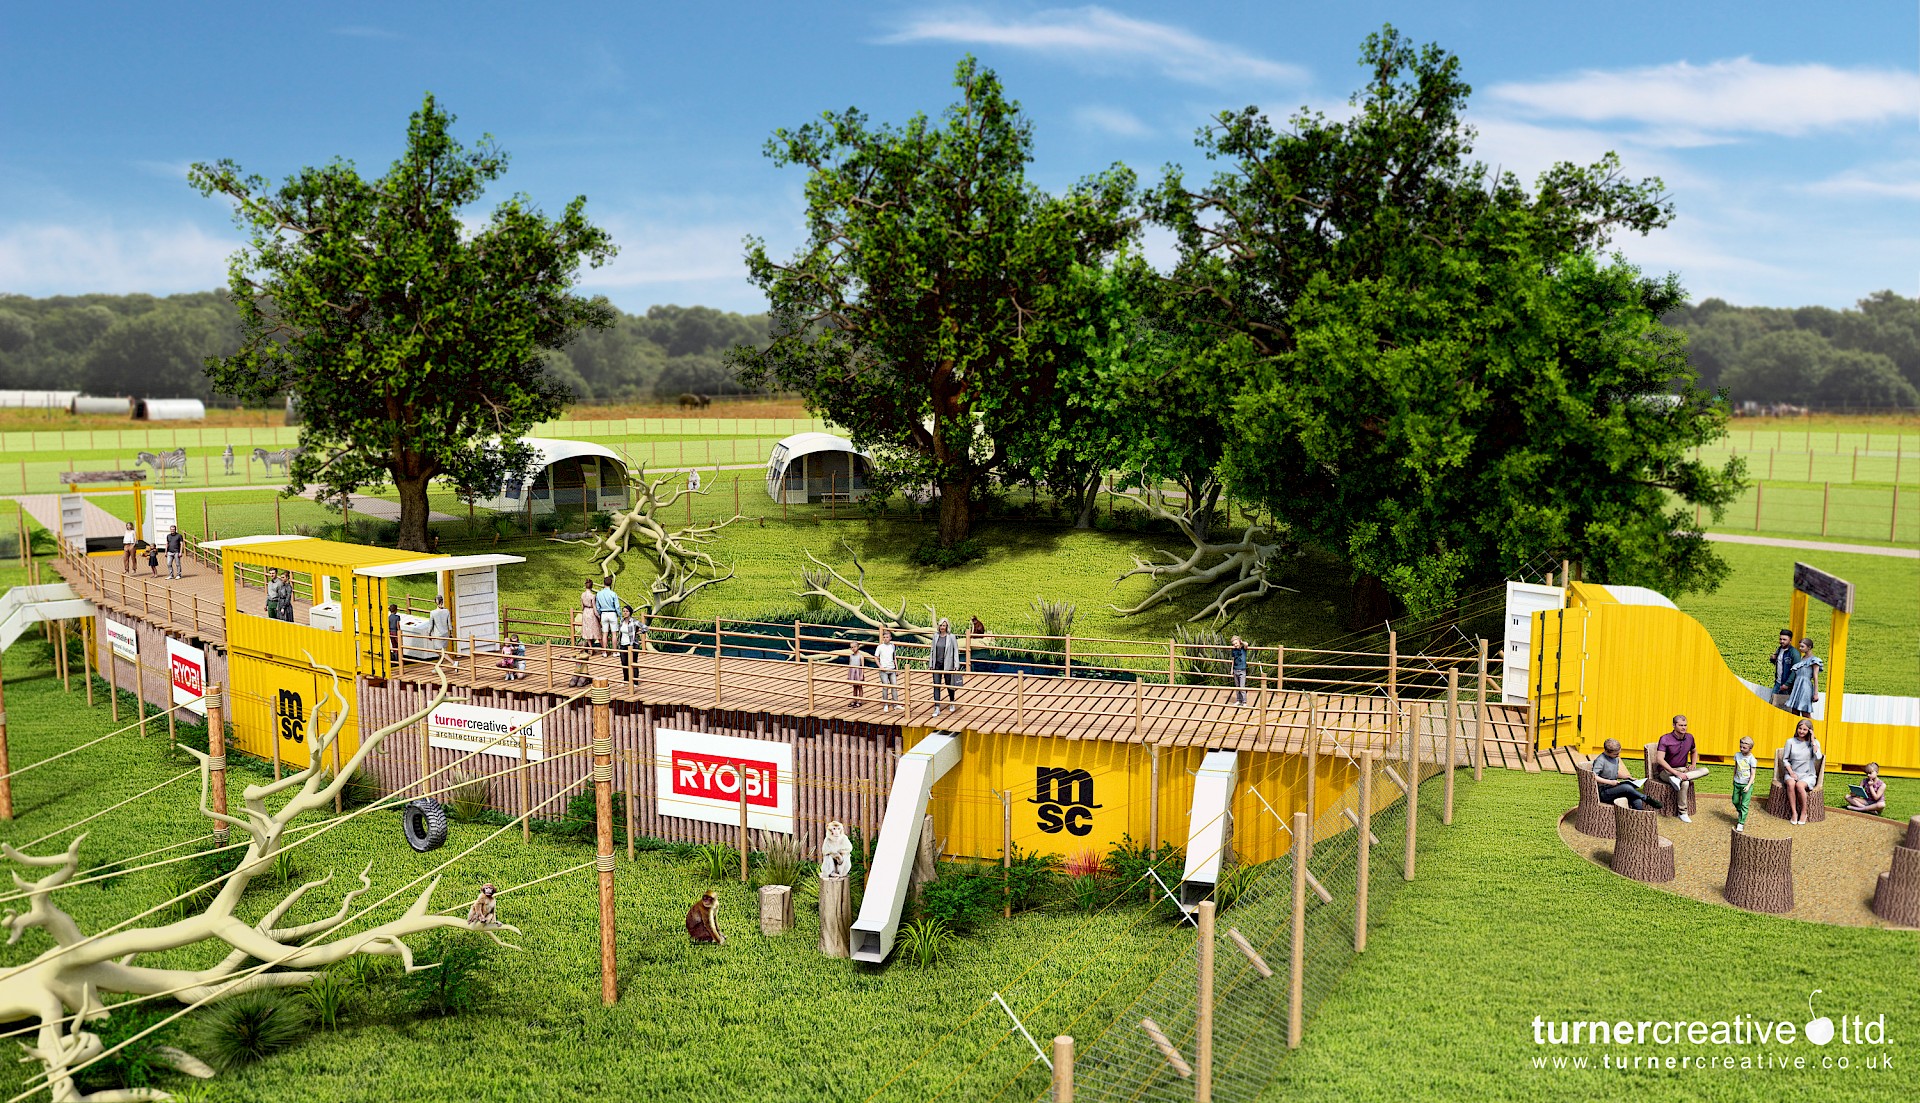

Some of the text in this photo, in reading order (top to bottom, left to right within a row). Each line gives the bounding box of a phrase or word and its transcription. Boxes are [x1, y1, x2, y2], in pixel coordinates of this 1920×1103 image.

[172, 660, 201, 691] RYOBI
[434, 713, 508, 734] turnercreative
[435, 731, 486, 743] architectural
[677, 758, 770, 799] RYOBI
